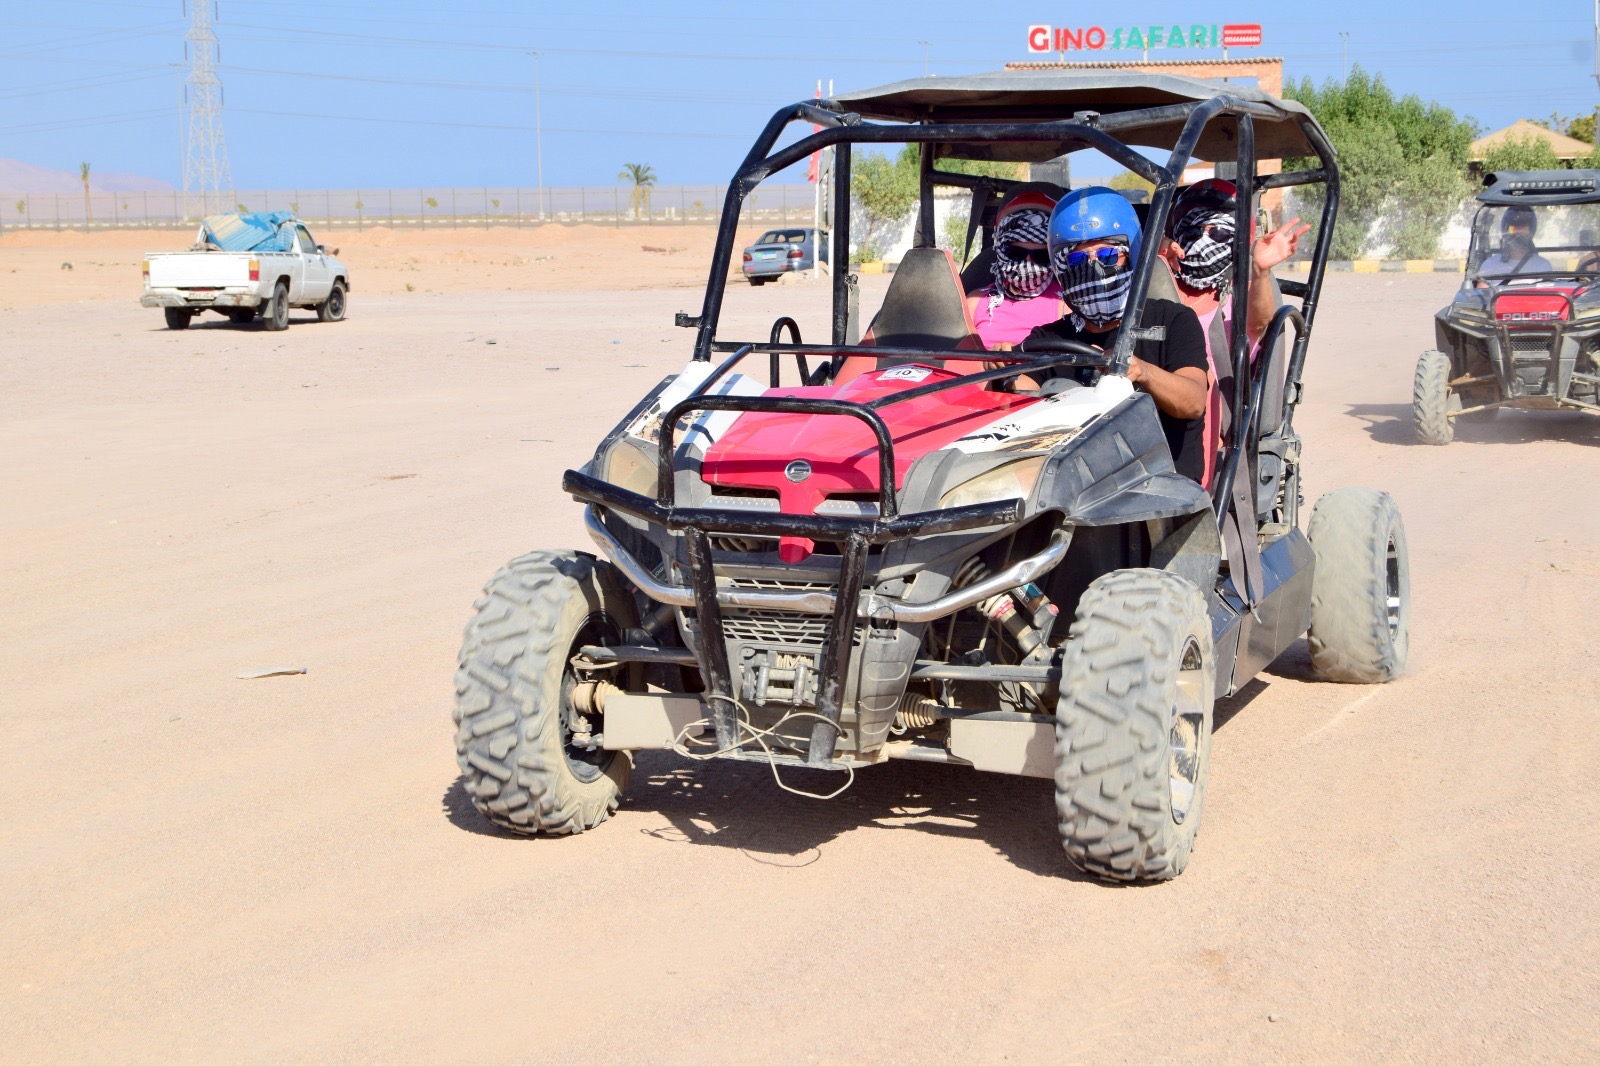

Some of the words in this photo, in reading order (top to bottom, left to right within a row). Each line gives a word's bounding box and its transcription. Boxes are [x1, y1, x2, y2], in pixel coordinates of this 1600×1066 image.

[1029, 26, 1106, 51] GINO
[1111, 24, 1218, 49] SAFARI
[1503, 311, 1560, 320] POLARIS
